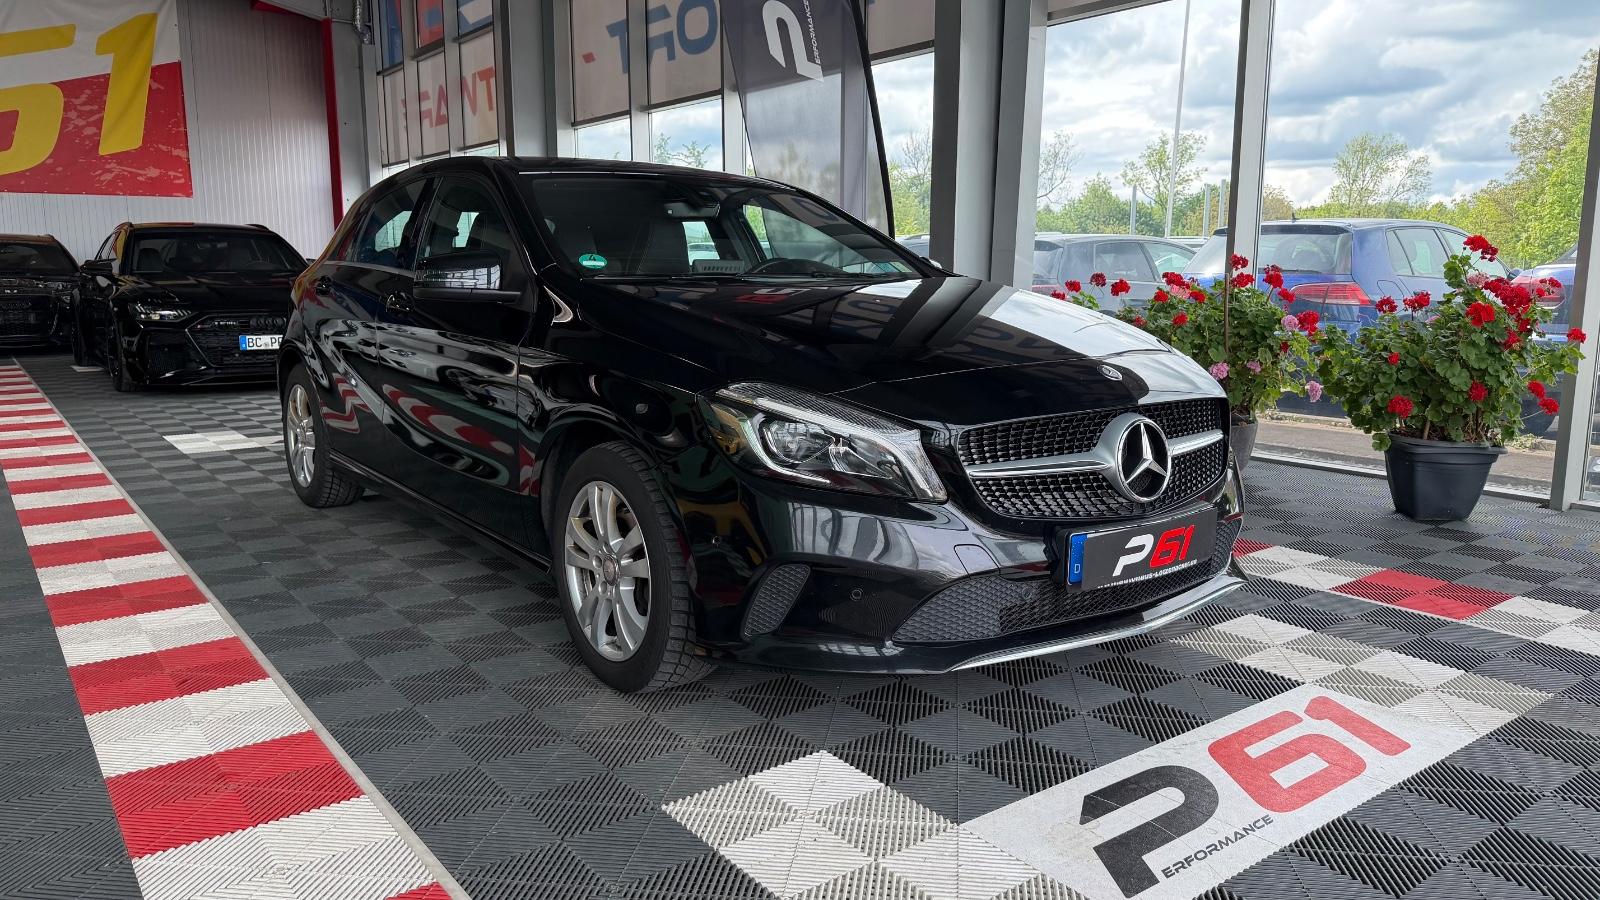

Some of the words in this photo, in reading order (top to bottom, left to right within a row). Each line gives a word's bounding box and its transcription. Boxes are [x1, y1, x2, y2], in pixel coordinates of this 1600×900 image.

[247, 337, 262, 348] BC
[1074, 563, 1081, 573] D
[1112, 524, 1196, 577] P61
[1079, 695, 1411, 899] P61
[1161, 814, 1275, 879] ERFORMANCE
